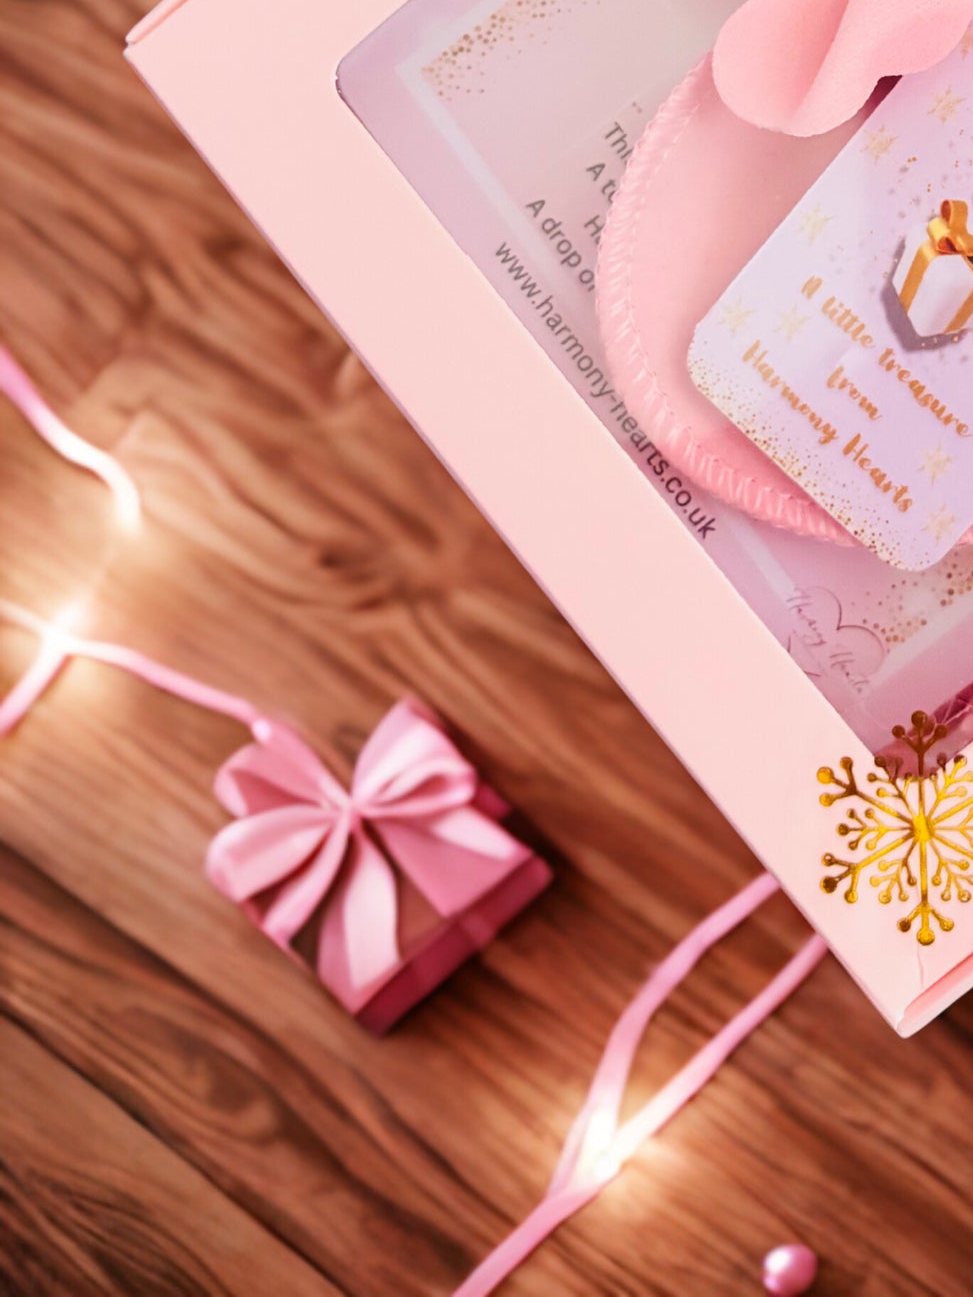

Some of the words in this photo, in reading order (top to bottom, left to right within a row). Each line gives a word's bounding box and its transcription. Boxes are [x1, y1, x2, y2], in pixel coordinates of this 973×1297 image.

[585, 162, 606, 182] A
[525, 198, 546, 219] A
[540, 216, 583, 269] drop
[801, 274, 823, 300] A
[821, 295, 875, 348] little
[877, 347, 972, 438] treasure
[742, 339, 839, 446] Harmony
[842, 432, 913, 514] Hearts
[826, 365, 882, 421] from
